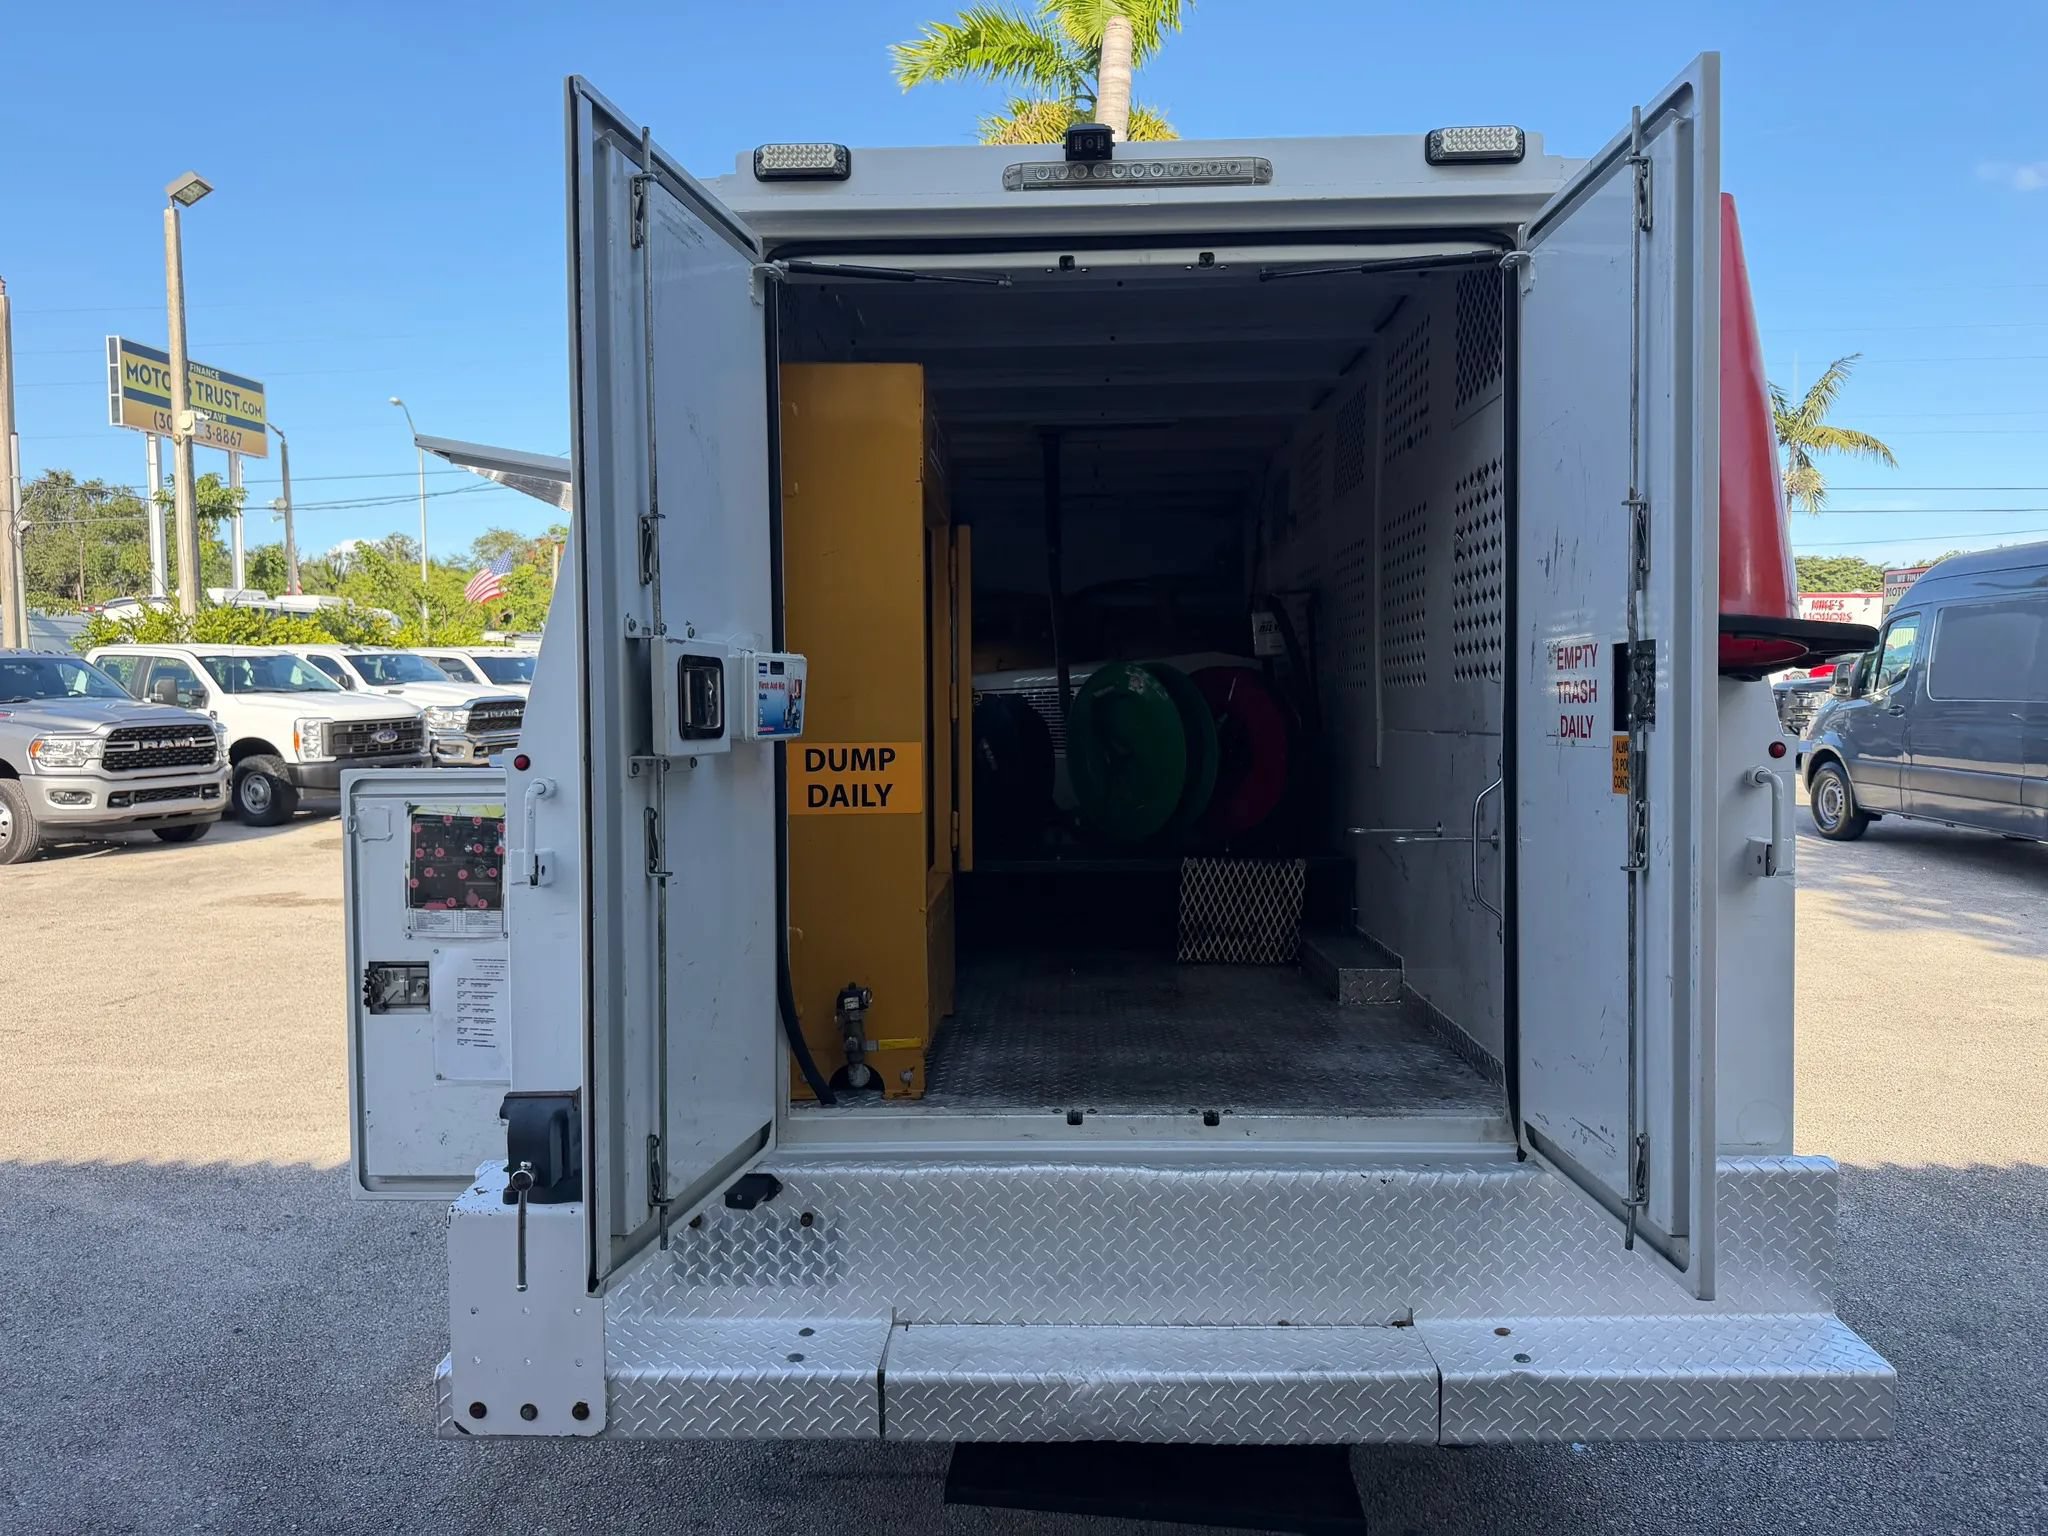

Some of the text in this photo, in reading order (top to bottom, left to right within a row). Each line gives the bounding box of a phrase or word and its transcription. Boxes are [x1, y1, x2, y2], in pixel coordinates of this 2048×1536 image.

[125, 359, 192, 399] MOTOS
[189, 363, 220, 380] FINANCE
[153, 410, 242, 447] (30 3-8867
[213, 412, 227, 424] AVE
[1811, 599, 1845, 611] MIKE'S
[1557, 642, 1598, 670] EMPTY
[1556, 679, 1598, 704] TRASH
[1560, 714, 1594, 739] DAILY
[142, 738, 195, 750] RAM
[805, 747, 896, 772] DUMP
[807, 783, 894, 808] DAILY
